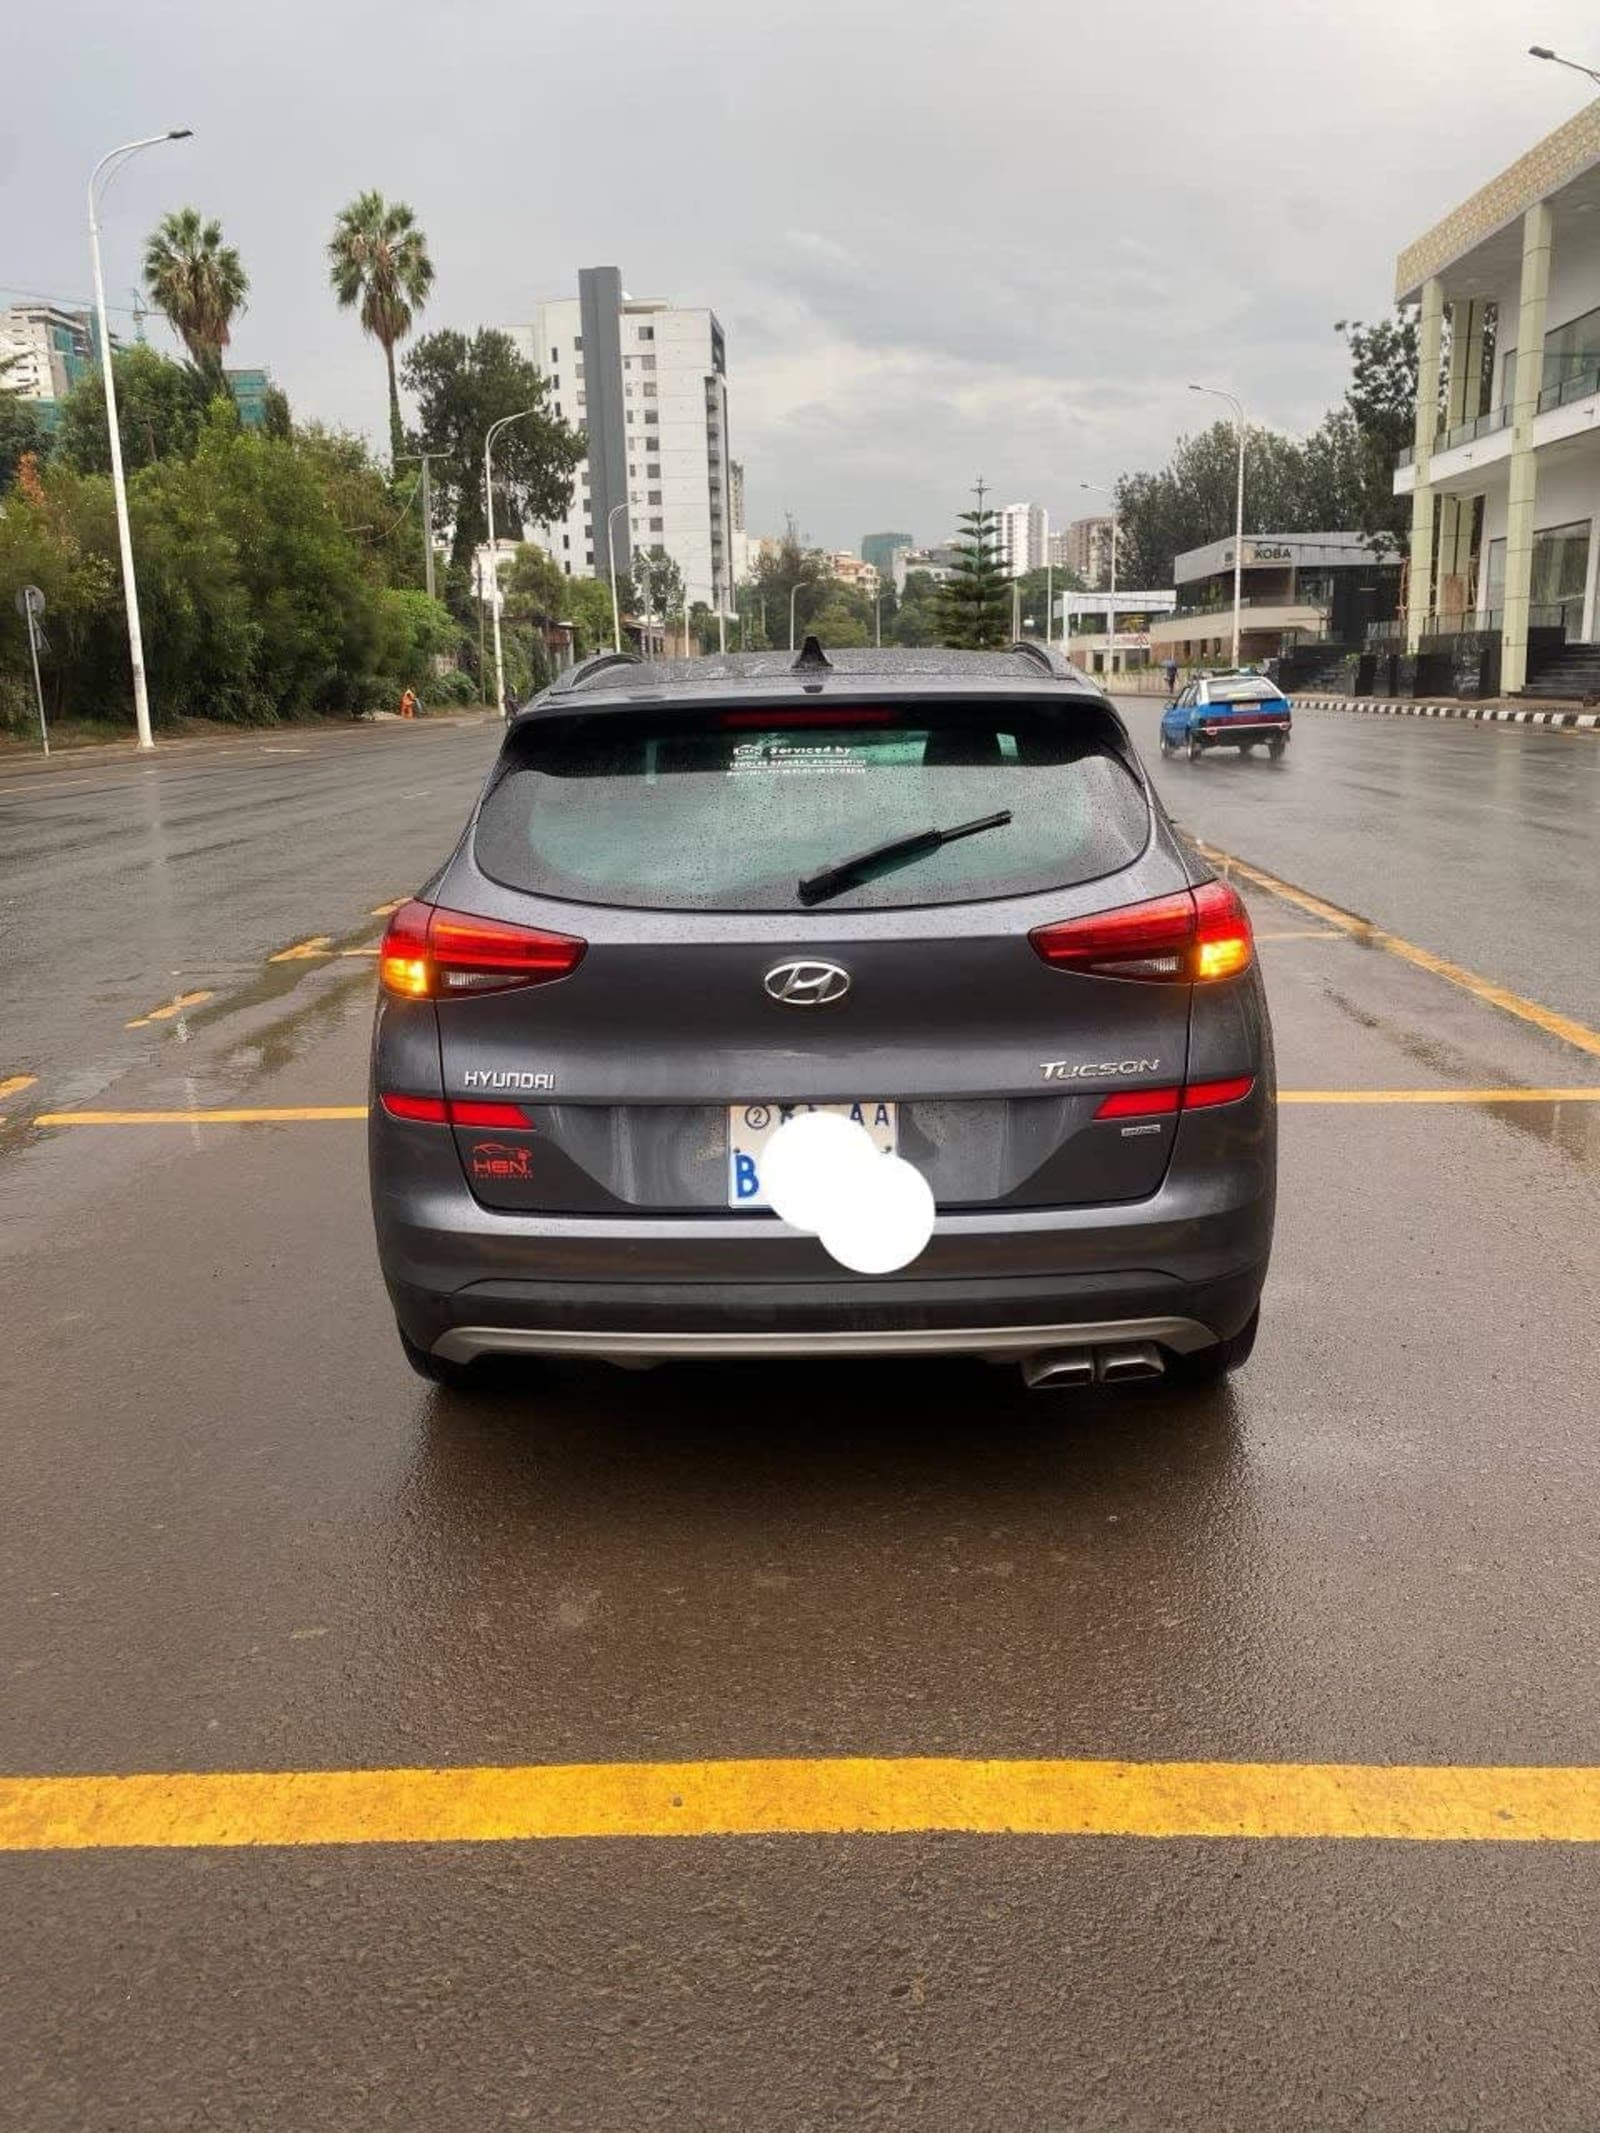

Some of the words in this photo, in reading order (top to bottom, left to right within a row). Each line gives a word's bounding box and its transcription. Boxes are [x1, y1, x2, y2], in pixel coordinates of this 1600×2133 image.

[1254, 548, 1292, 561] KOBA
[769, 745, 831, 755] Serviced
[834, 745, 851, 757] by
[1039, 1058, 1161, 1081] TUCSON
[464, 1071, 555, 1089] HYUNDAI
